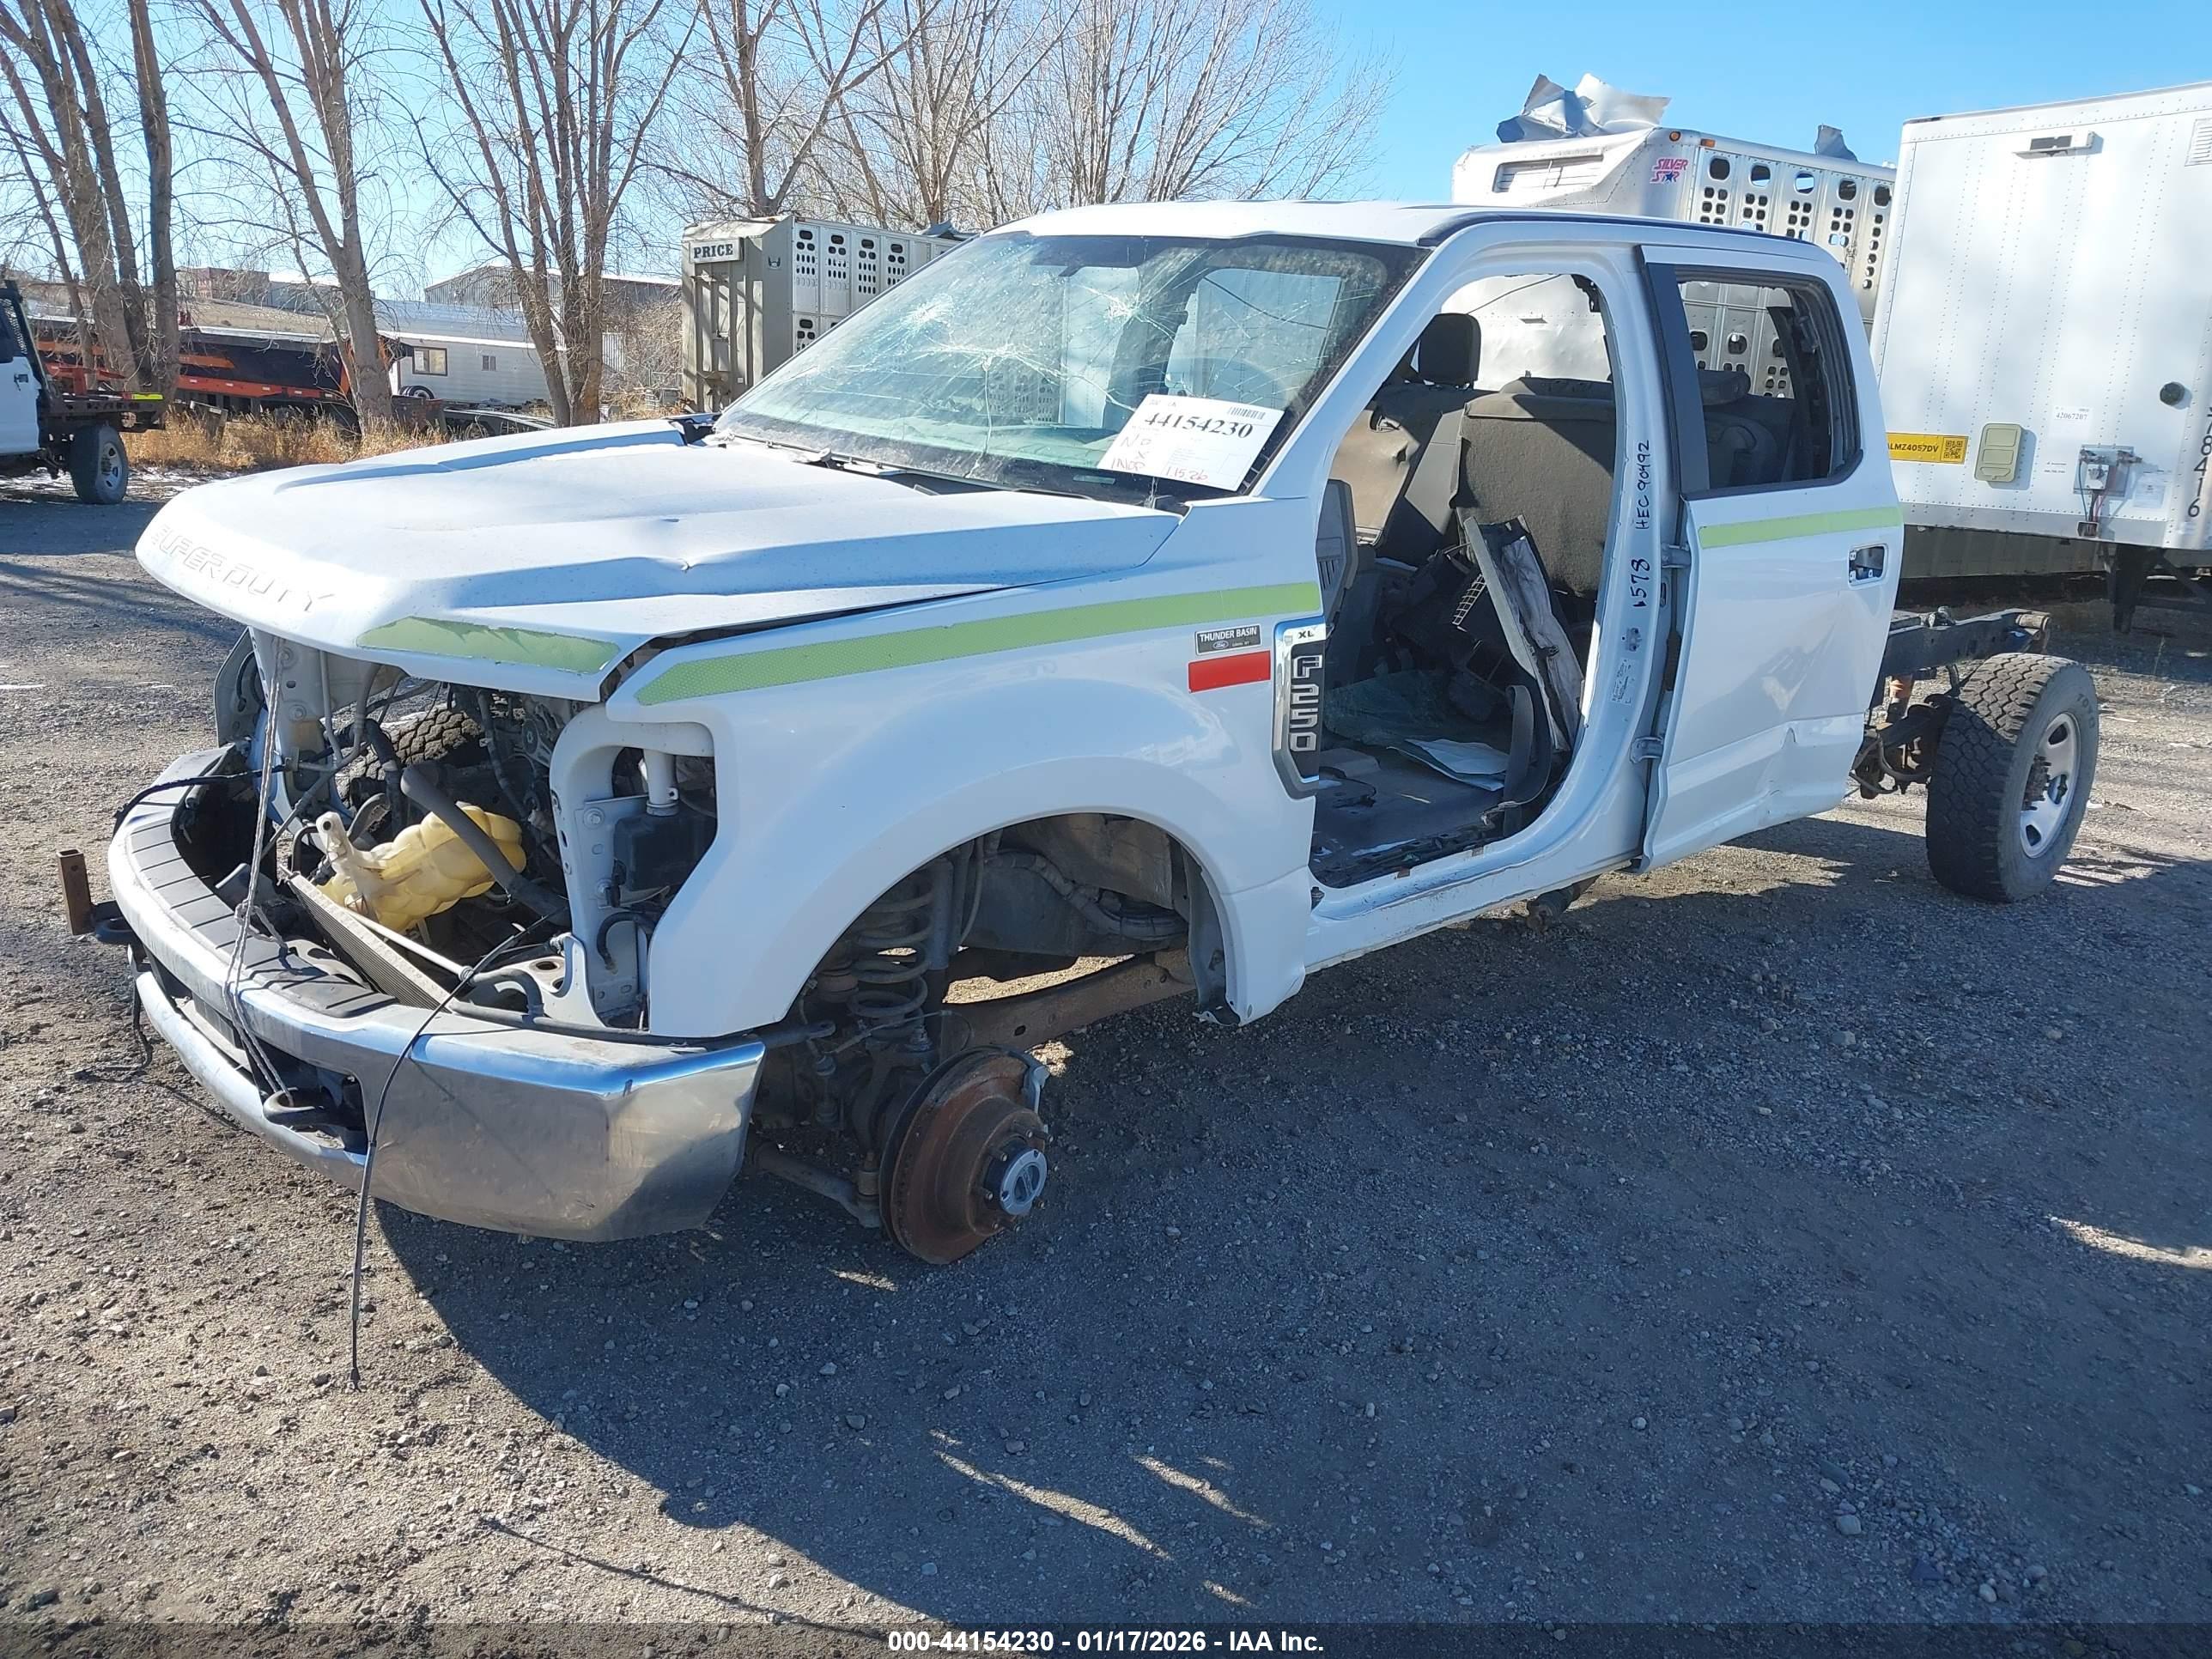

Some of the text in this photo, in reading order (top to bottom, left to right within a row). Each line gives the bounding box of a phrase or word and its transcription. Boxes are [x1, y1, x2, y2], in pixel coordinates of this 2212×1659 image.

[1653, 158, 1688, 171] SILVER
[693, 244, 733, 258] PRICE
[1145, 412, 1253, 439] 44154230
[1635, 439, 1650, 531] HEC 90492
[222, 562, 336, 612] DUTY
[1199, 627, 1257, 642] THUNDER BASIN
[1297, 629, 1315, 639] XL
[1289, 654, 1322, 752] F250
